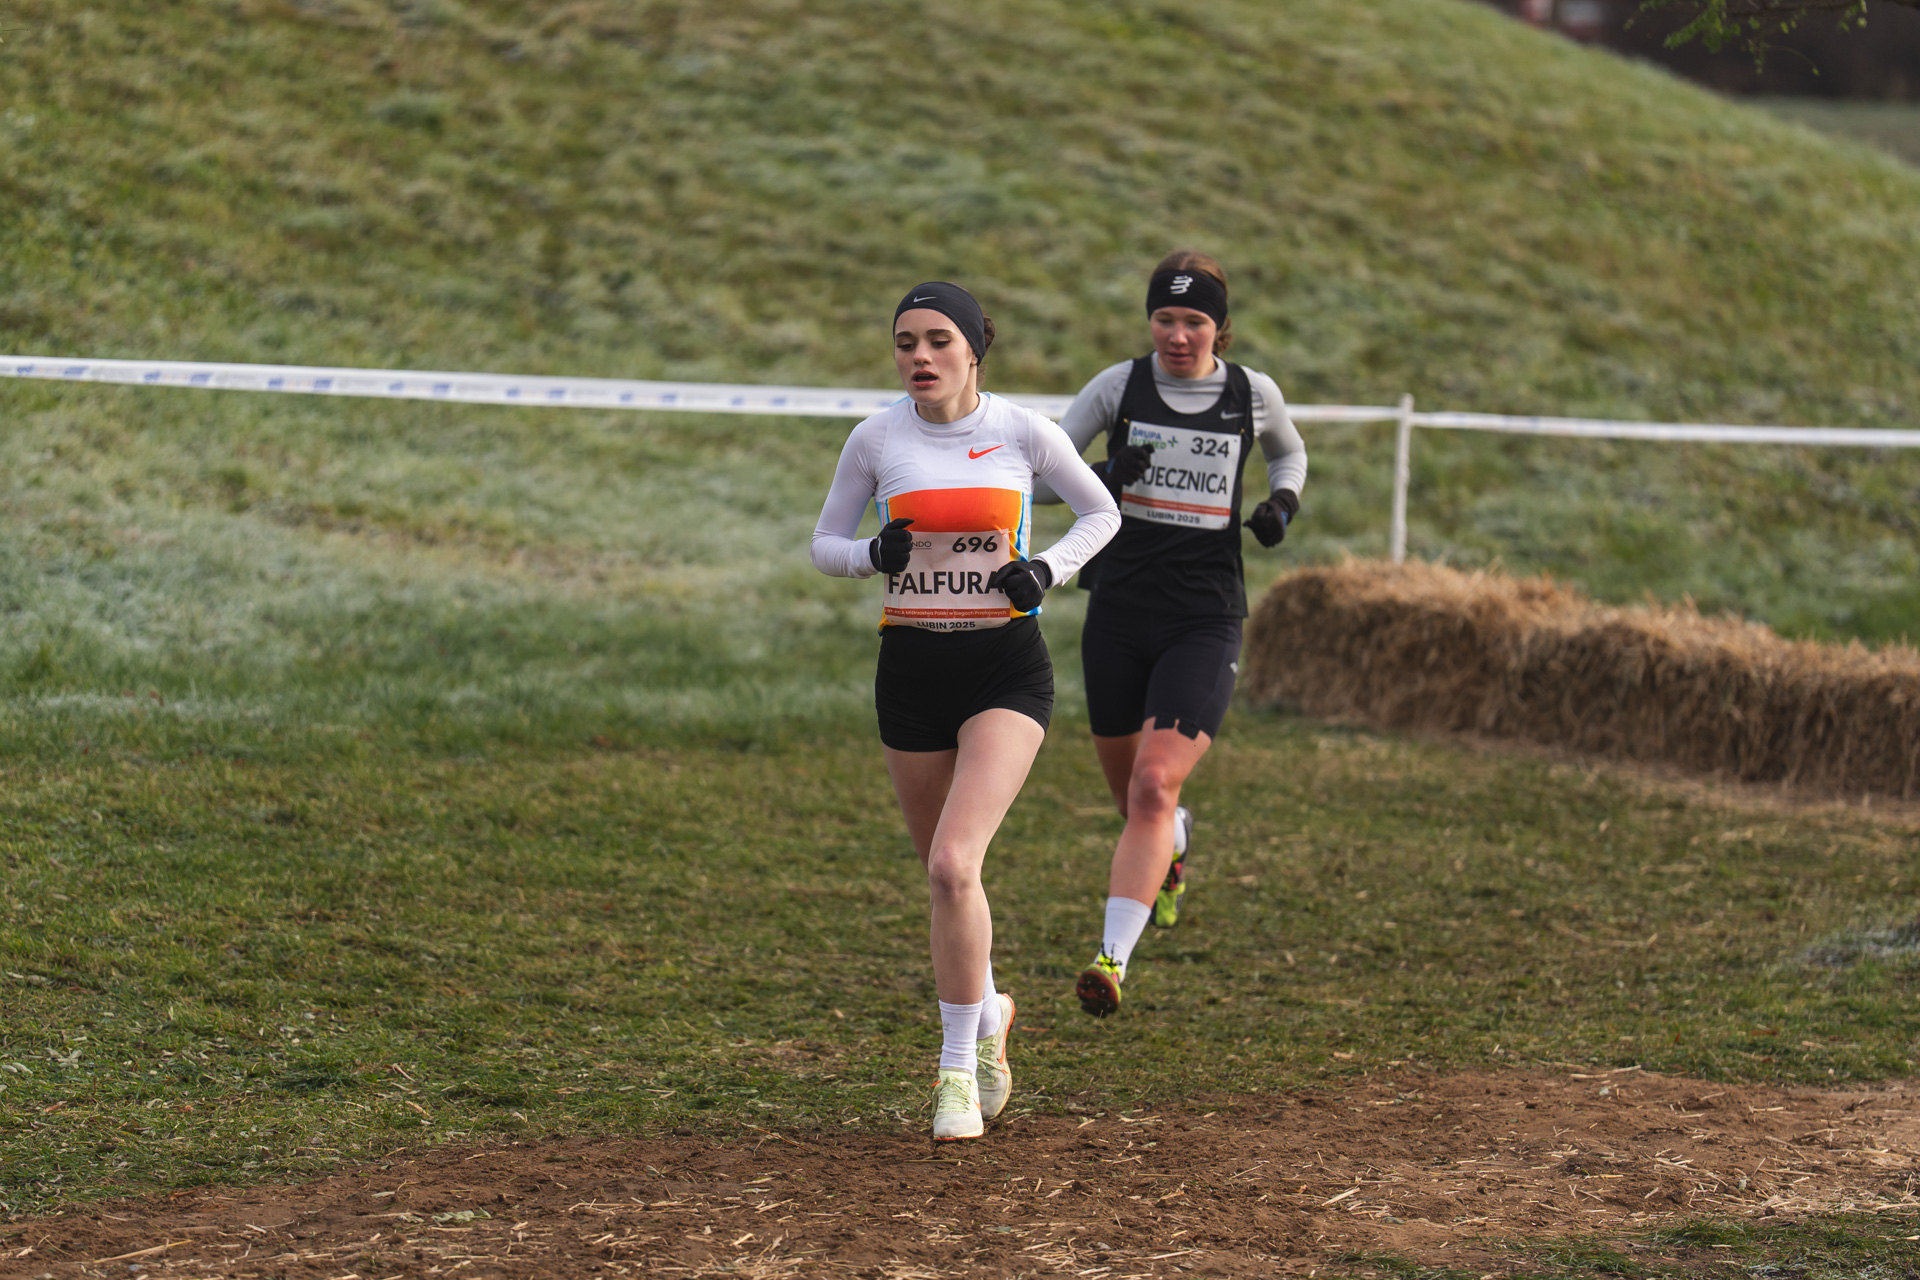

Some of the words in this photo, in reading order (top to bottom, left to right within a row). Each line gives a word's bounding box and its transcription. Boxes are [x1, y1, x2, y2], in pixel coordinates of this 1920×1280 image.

[1131, 427, 1161, 440] GRUPA
[1191, 436, 1229, 458] 324
[1140, 465, 1227, 495] JECZNICA
[1146, 510, 1175, 521] LUBIN
[1177, 514, 1201, 524] 2025
[952, 535, 998, 553] 696
[888, 571, 1004, 595] FALFURA
[916, 621, 947, 629] LUBIN
[949, 621, 976, 629] 2025
